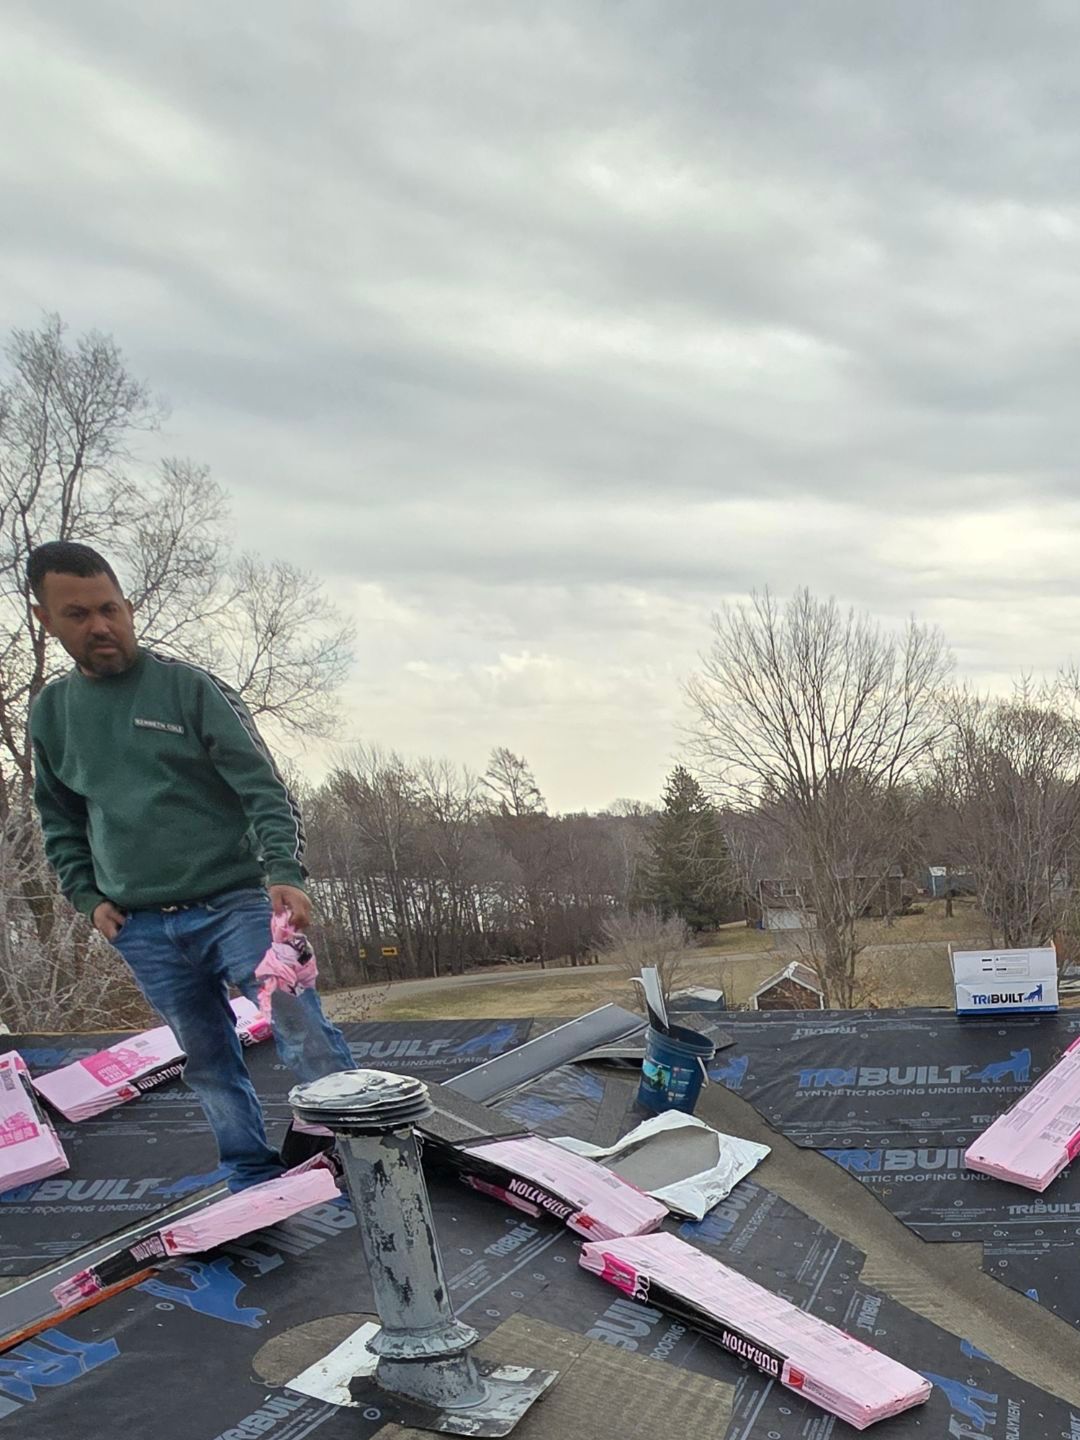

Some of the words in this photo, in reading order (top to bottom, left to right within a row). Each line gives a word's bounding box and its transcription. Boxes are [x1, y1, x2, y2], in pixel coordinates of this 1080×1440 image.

[972, 992, 1025, 1005] TRIBUILT
[348, 1039, 451, 1057] BUILT
[799, 1066, 974, 1088] TRIBUILT
[795, 1089, 866, 1098] SYNTHETIC
[868, 1088, 924, 1096] ROOFING
[928, 1085, 1028, 1095] UNDERLAYMENT
[892, 1172, 956, 1182] ROOFING
[509, 1178, 571, 1218] DURATION
[722, 1330, 780, 1375] DURATION
